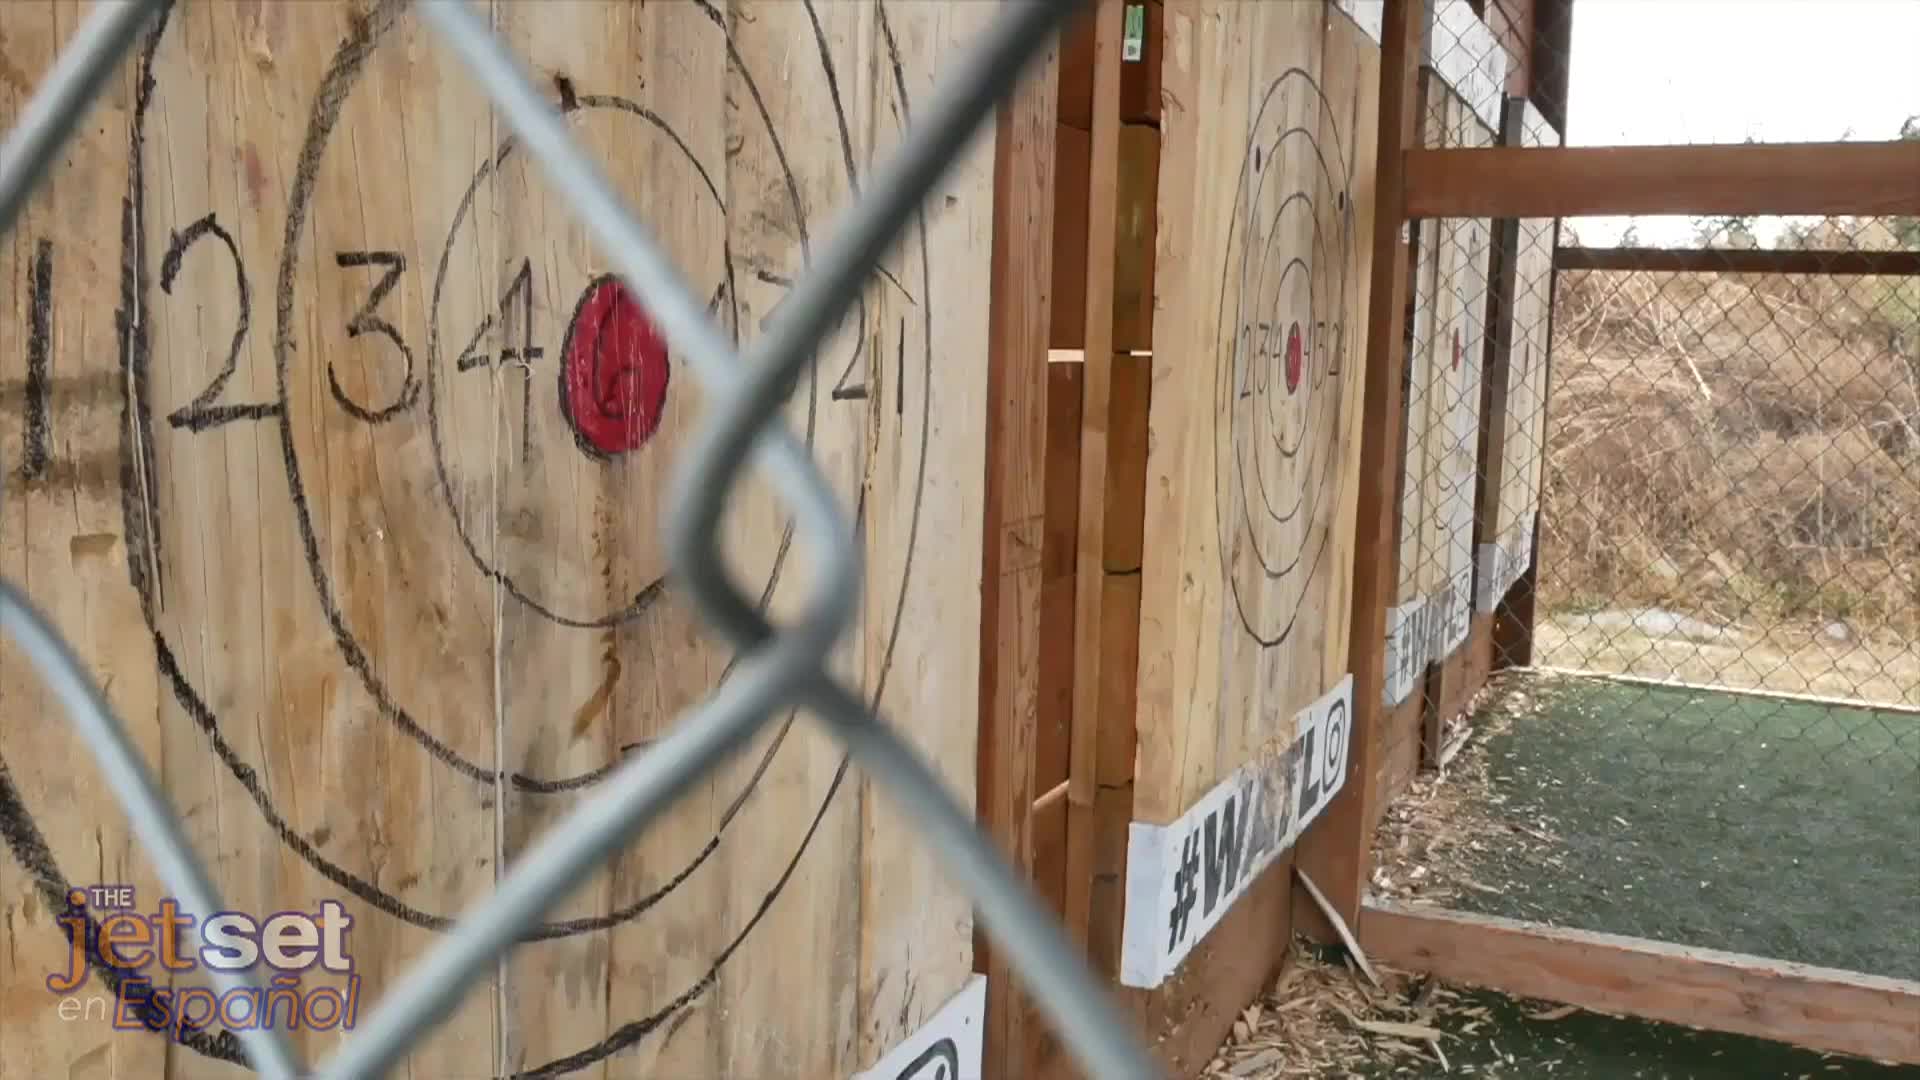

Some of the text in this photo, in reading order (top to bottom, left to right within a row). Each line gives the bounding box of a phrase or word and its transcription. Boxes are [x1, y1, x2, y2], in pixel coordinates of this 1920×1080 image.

[22, 238, 52, 481] 1
[160, 212, 283, 434] 2
[327, 250, 422, 425] 3
[457, 256, 544, 464] 4
[1239, 324, 1251, 400] 2
[1256, 322, 1270, 395] 3
